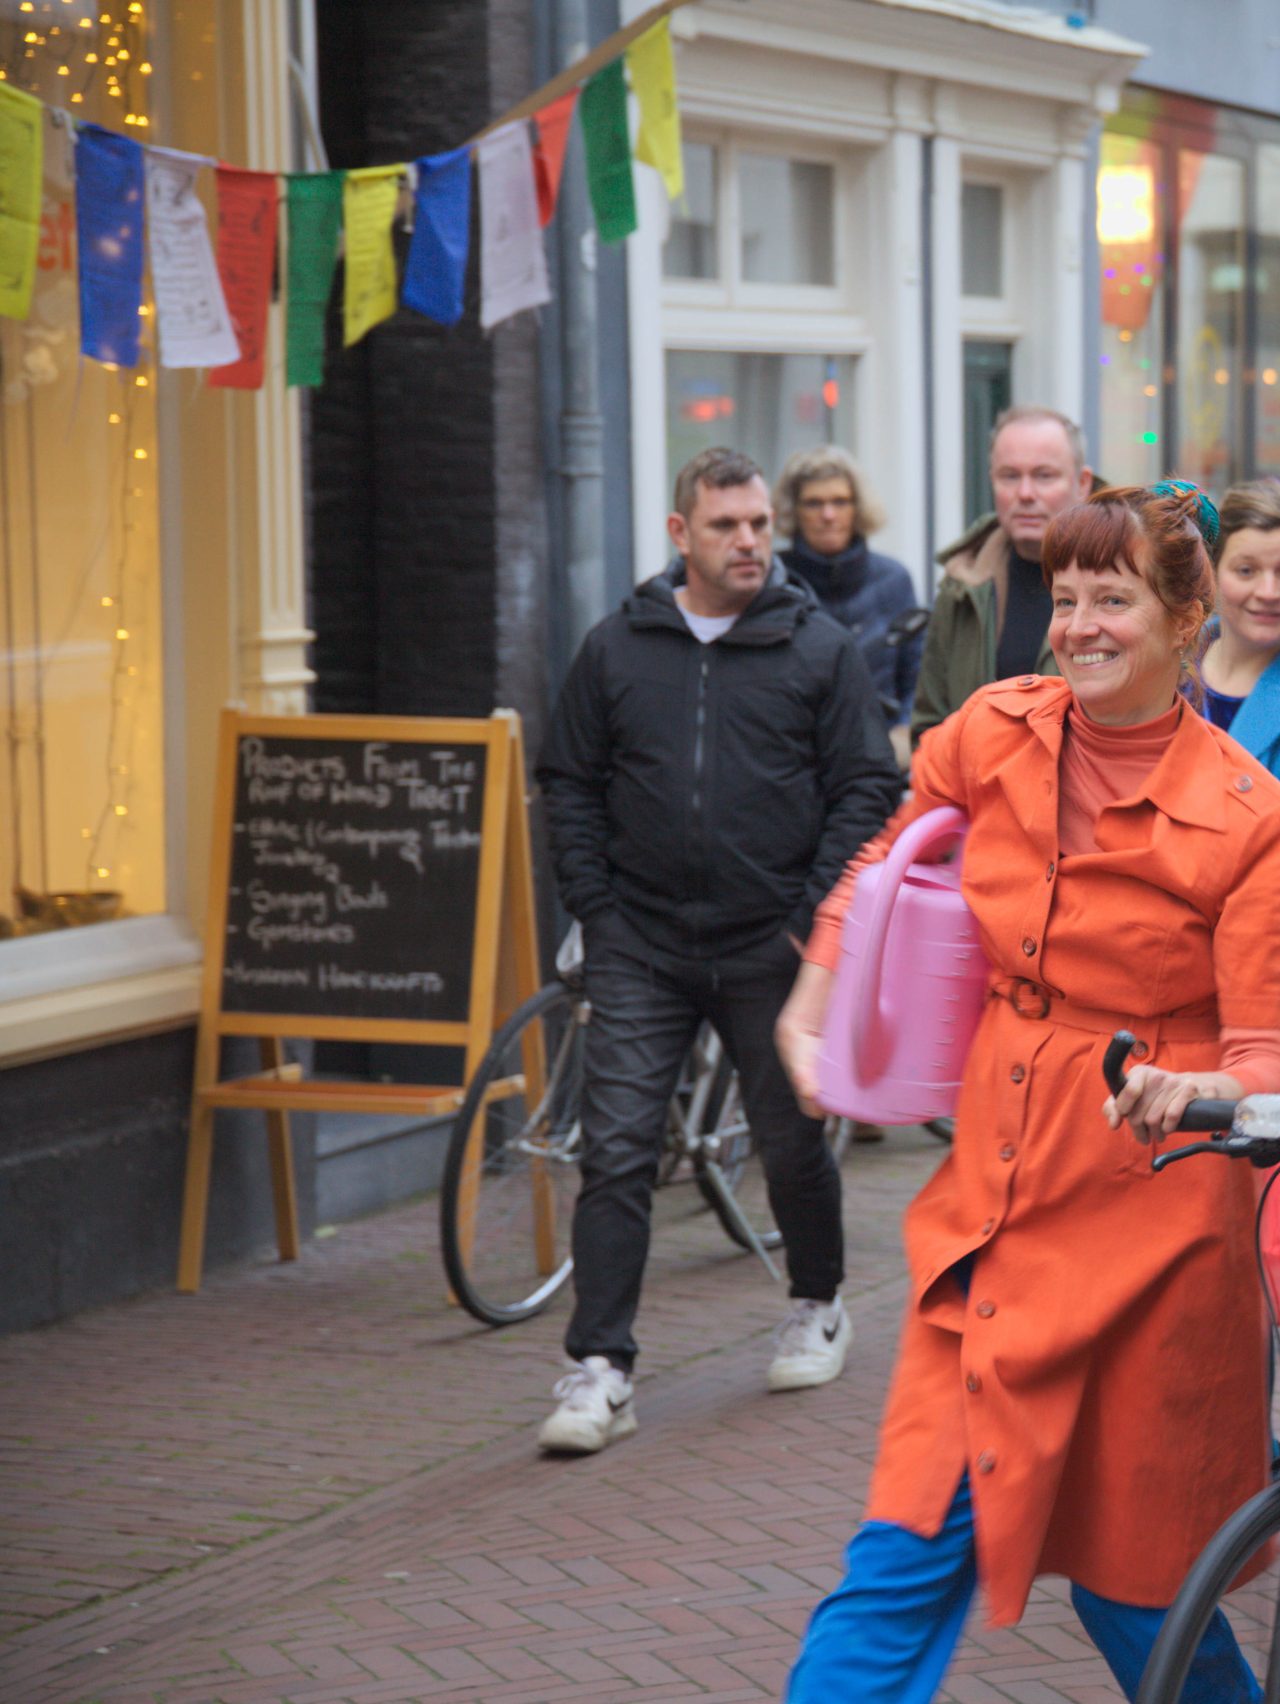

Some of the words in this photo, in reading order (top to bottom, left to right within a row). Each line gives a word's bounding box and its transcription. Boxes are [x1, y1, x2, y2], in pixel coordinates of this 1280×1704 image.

[363, 742, 420, 783] FROM
[430, 751, 477, 783] THE
[396, 777, 473, 814] TIBET
